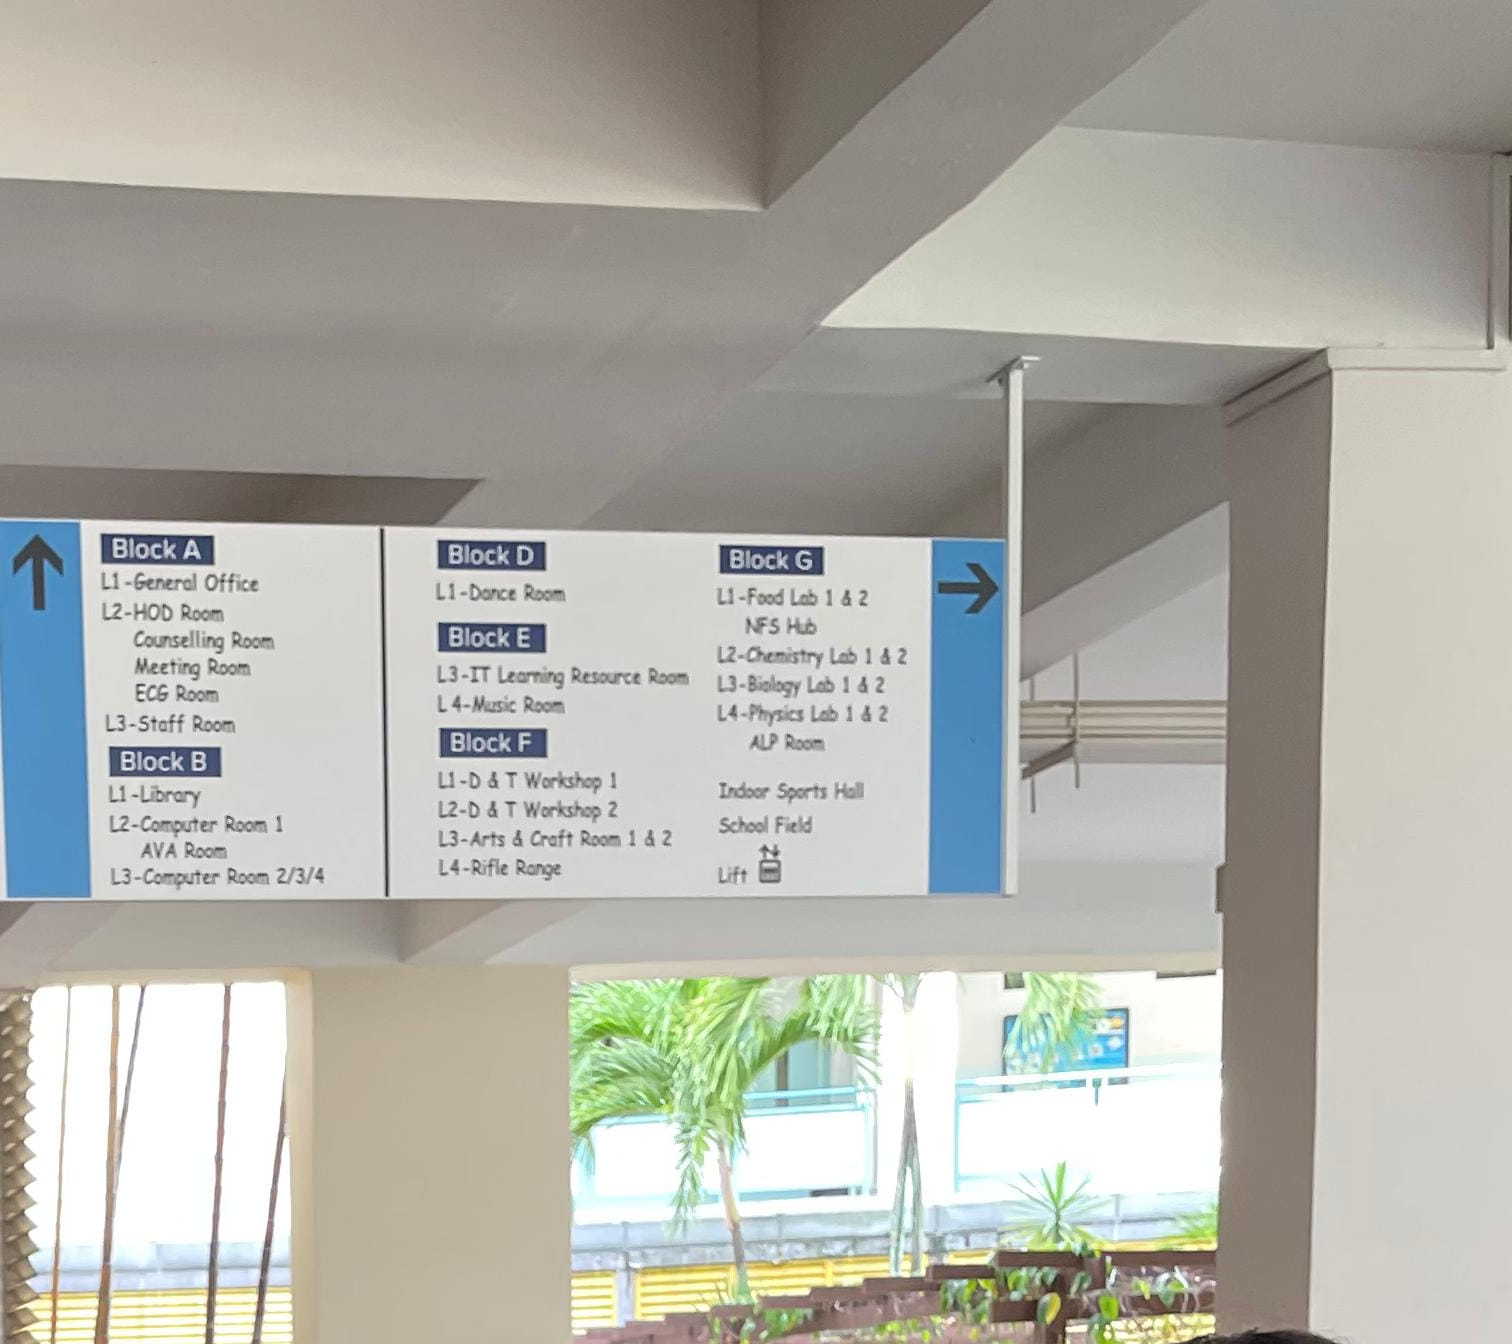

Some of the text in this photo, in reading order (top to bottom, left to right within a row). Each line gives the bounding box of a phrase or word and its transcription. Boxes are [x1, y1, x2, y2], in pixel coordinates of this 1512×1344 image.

[113, 538, 201, 559] Block A
[449, 544, 534, 565] Block D
[730, 549, 812, 570] Block G
[102, 572, 258, 592] L1-General Office
[436, 583, 565, 601] L1-Dance Room
[718, 588, 868, 606] L1-Food Lab 1 & 2
[103, 603, 224, 621] L2-HOD Room
[746, 617, 817, 635] NFS Hub
[134, 631, 274, 654] Counselling Room
[449, 627, 530, 648] Block E
[718, 646, 907, 669] L2-Chemistry Lab 1 & 2
[135, 658, 250, 681] Meeting Room
[438, 666, 689, 689] L3-IT Learning Resource Room
[136, 684, 219, 702] ECG Room
[718, 675, 884, 698] L3-Biology Lab 1 & 2
[524, 696, 565, 713] Room
[718, 704, 888, 726] L4-Physics Lab 1 & 2
[106, 714, 235, 732] L3-Staff Room
[451, 732, 531, 752] Block F
[750, 733, 824, 751] ALP Room
[121, 751, 206, 771] Block B
[439, 772, 616, 794] L1-D & T Workshop 1
[719, 782, 864, 803] Indoor Sports Hall
[109, 786, 200, 808] L1-Library
[439, 801, 617, 822] L2-D & T Workshop 2
[110, 815, 282, 837] L2-Computer Room 1
[719, 816, 812, 834] School Field
[439, 829, 671, 847] L3-Arts & Craft Room 1 & 2
[141, 842, 227, 858] AVA Room
[111, 867, 324, 889] L3-Computer Room 2/3/4
[440, 859, 561, 881] L4-Rifle Range
[719, 866, 747, 884] Lift
